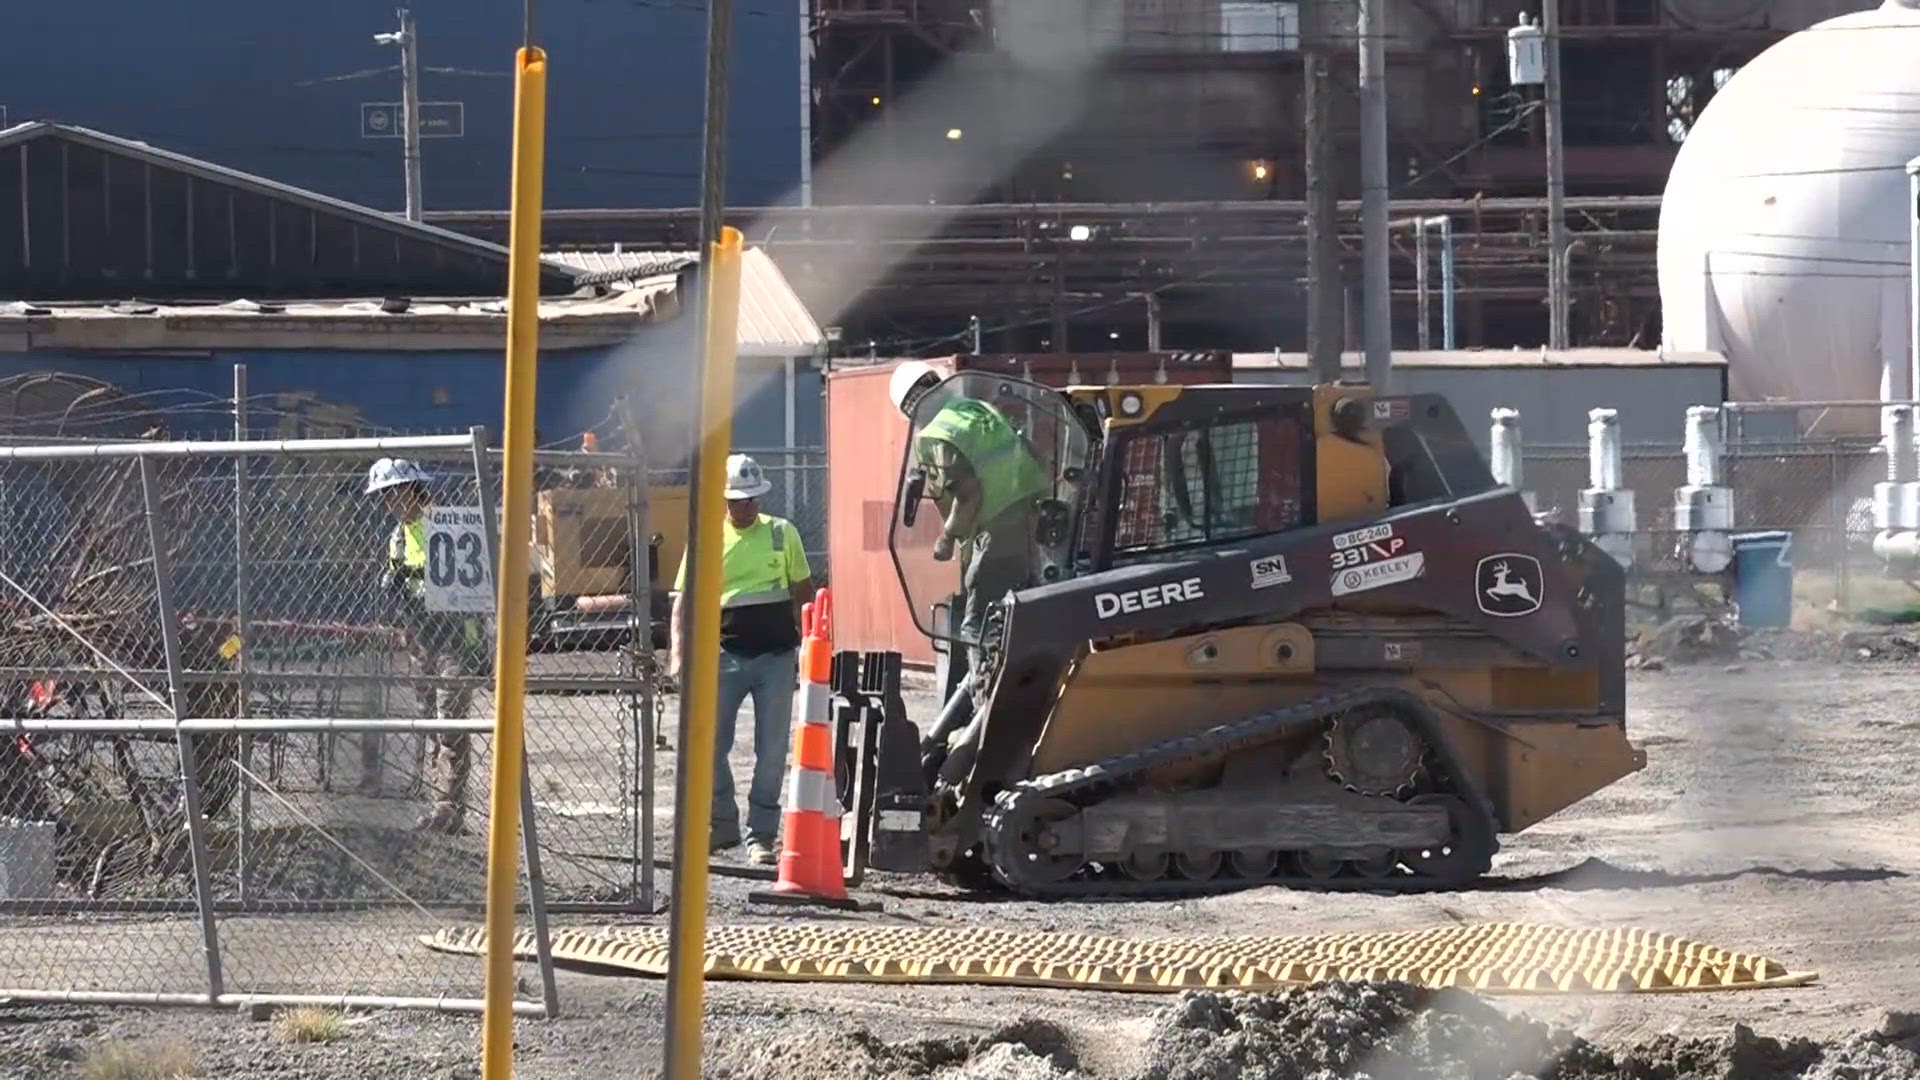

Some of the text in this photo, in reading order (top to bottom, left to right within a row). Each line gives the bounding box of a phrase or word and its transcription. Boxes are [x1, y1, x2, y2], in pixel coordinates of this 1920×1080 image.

[433, 511, 459, 525] GATE
[1346, 526, 1390, 544] BC-240
[428, 531, 484, 588] 03
[1362, 559, 1410, 578] KEELEY
[1094, 576, 1205, 620] DEERE
